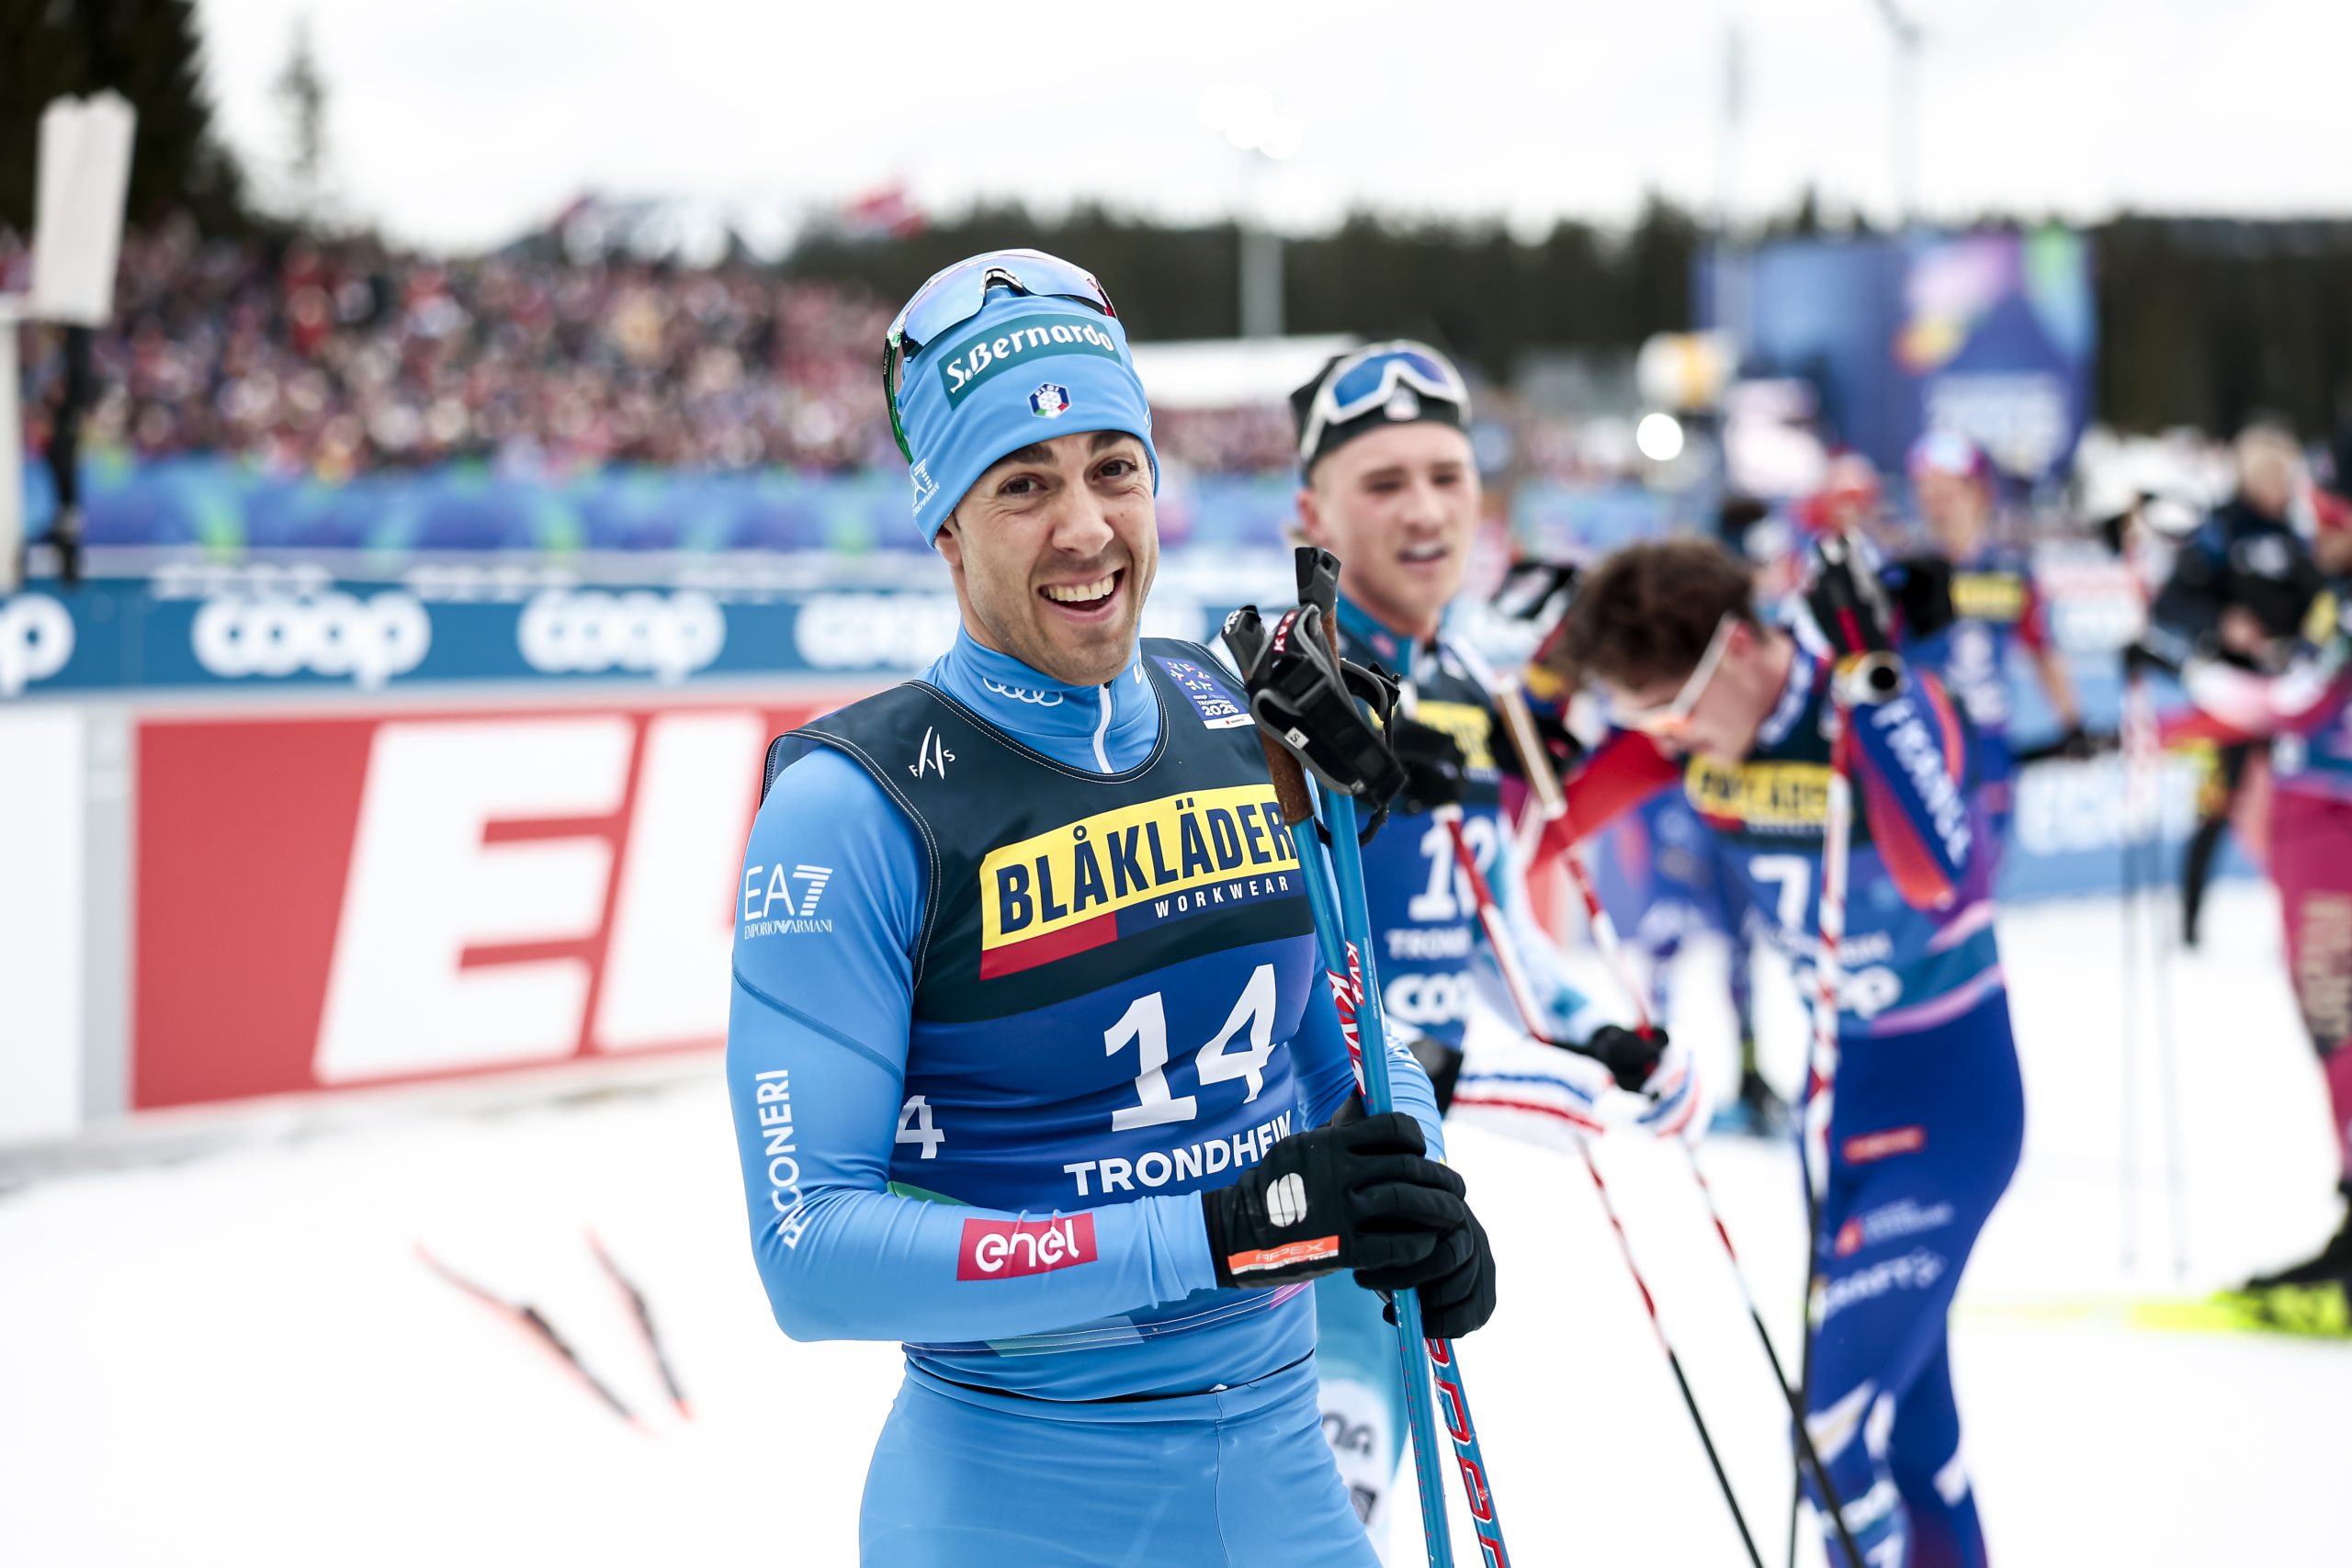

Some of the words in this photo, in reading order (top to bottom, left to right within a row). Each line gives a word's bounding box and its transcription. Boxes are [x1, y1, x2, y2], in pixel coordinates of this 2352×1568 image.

[946, 323, 1114, 393] S.Bernardo
[190, 591, 432, 692] coop
[517, 591, 726, 684] coop
[1201, 703, 1239, 716] 2025
[744, 863, 833, 921] EA7
[996, 797, 1298, 935] BLÅKLÄDER
[1155, 875, 1289, 919] WORKWEAR
[744, 920, 778, 940] EMPORIO
[789, 919, 832, 933] ARMANI
[1103, 963, 1276, 1133] 14
[755, 1069, 812, 1249] FACONERI
[975, 1219, 1080, 1273] enel
